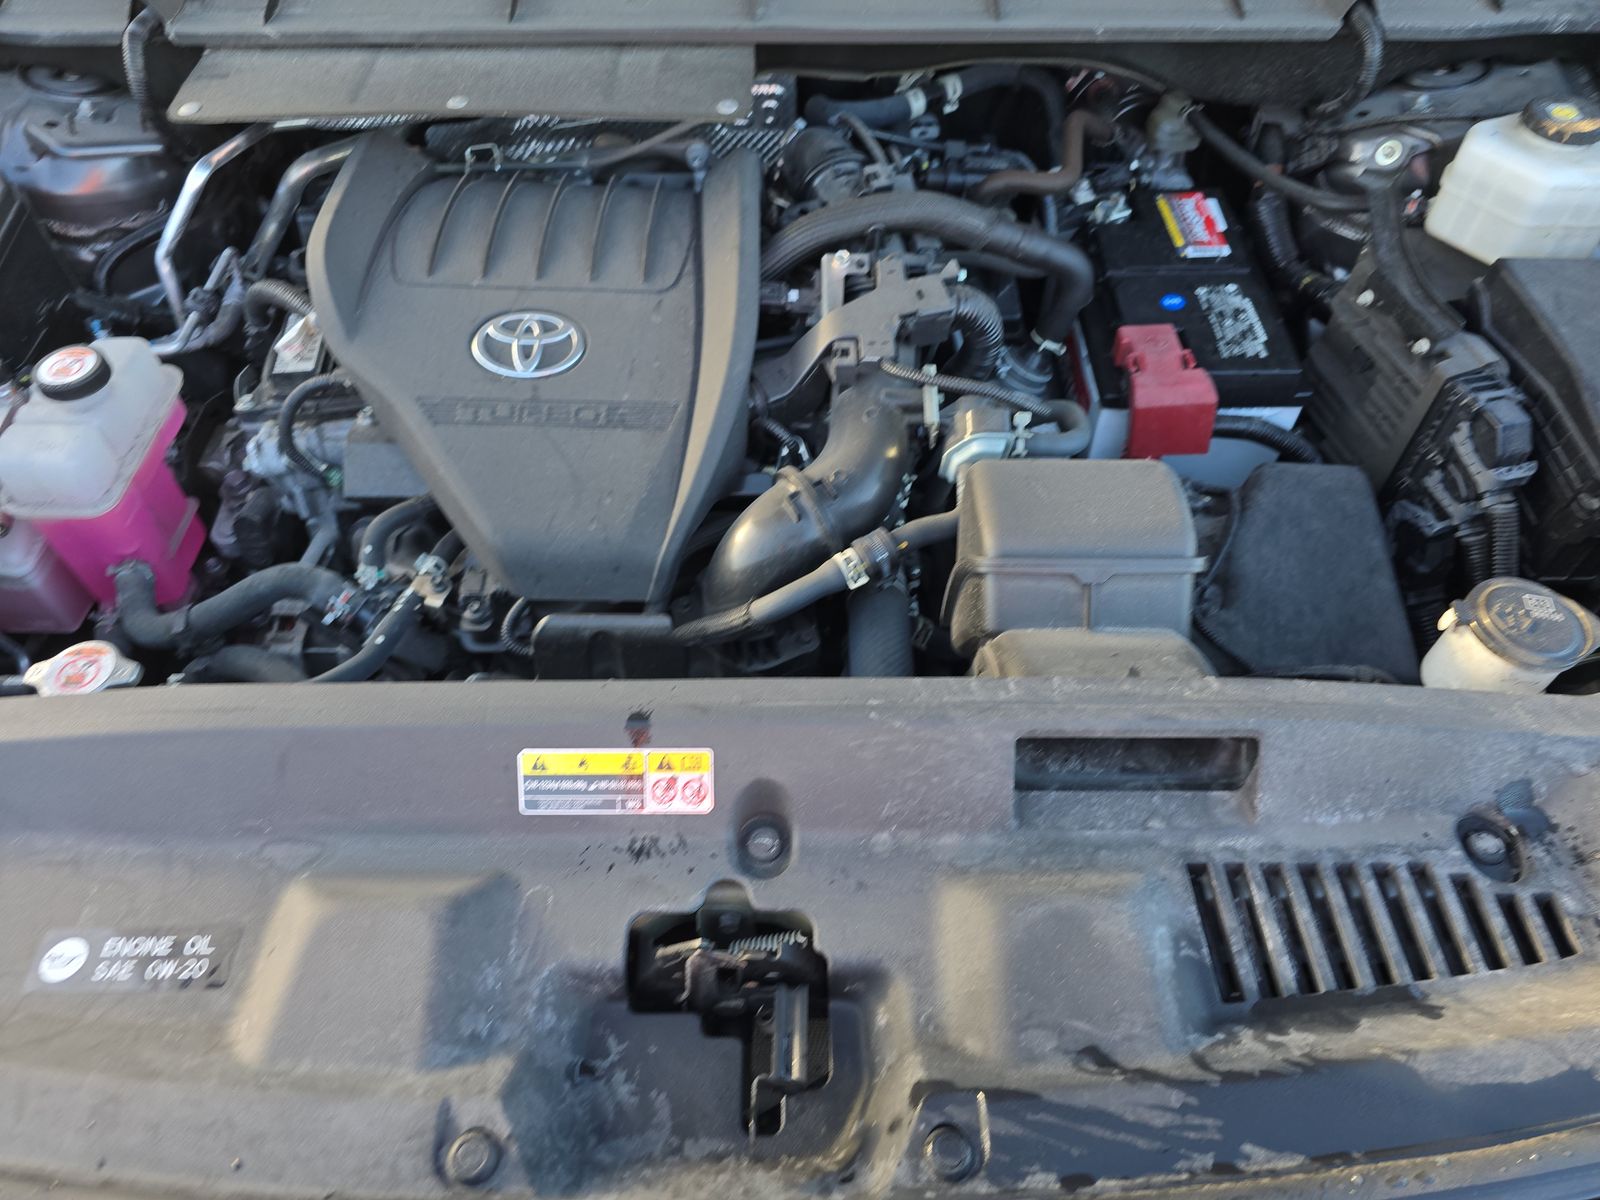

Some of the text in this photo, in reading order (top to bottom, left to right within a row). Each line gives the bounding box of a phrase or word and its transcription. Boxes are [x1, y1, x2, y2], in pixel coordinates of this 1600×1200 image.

[100, 934, 216, 958] ENGINE OIL
[90, 959, 138, 982] SAE
